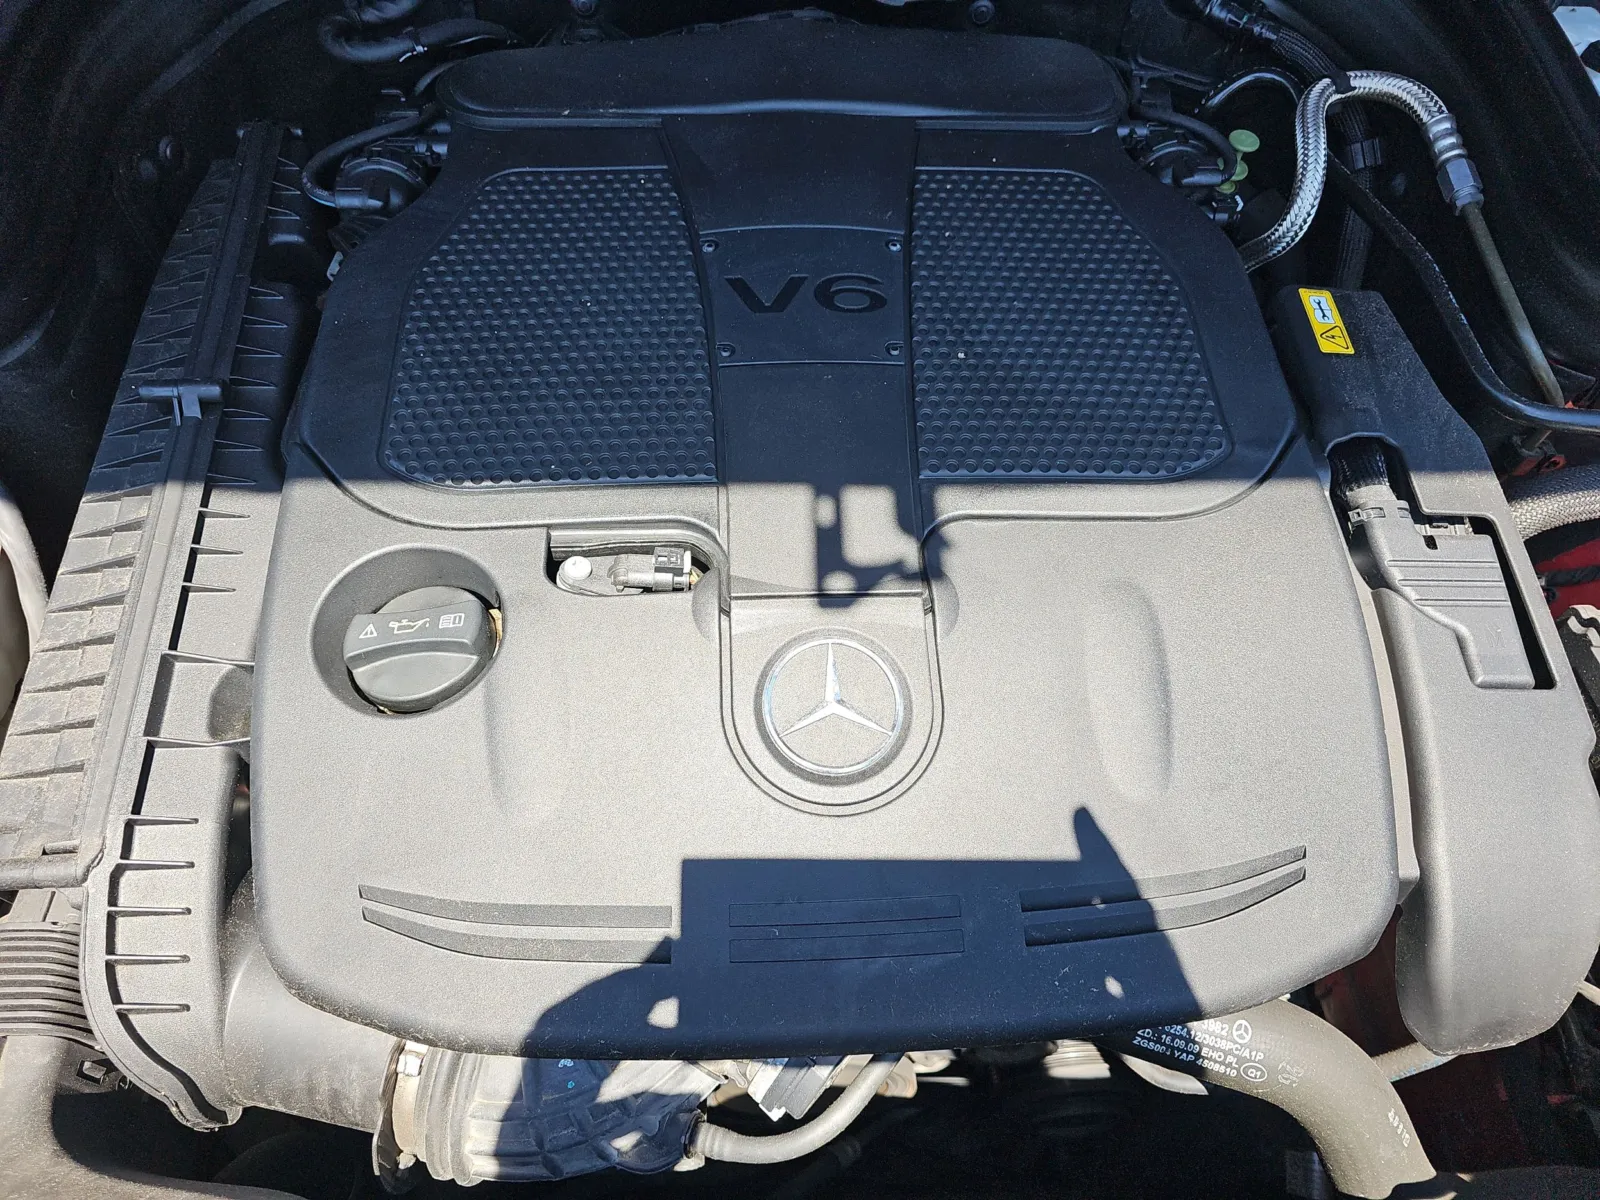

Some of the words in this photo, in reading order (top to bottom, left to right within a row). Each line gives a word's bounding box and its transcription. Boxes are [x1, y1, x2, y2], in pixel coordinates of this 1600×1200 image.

[723, 272, 888, 314] V6
[1160, 1034, 1200, 1054] 16.09.09
[1201, 1046, 1225, 1062] EHO
[1225, 1054, 1239, 1068] PL
[1173, 1049, 1195, 1063] YAP
[1247, 1066, 1262, 1079] Q1
